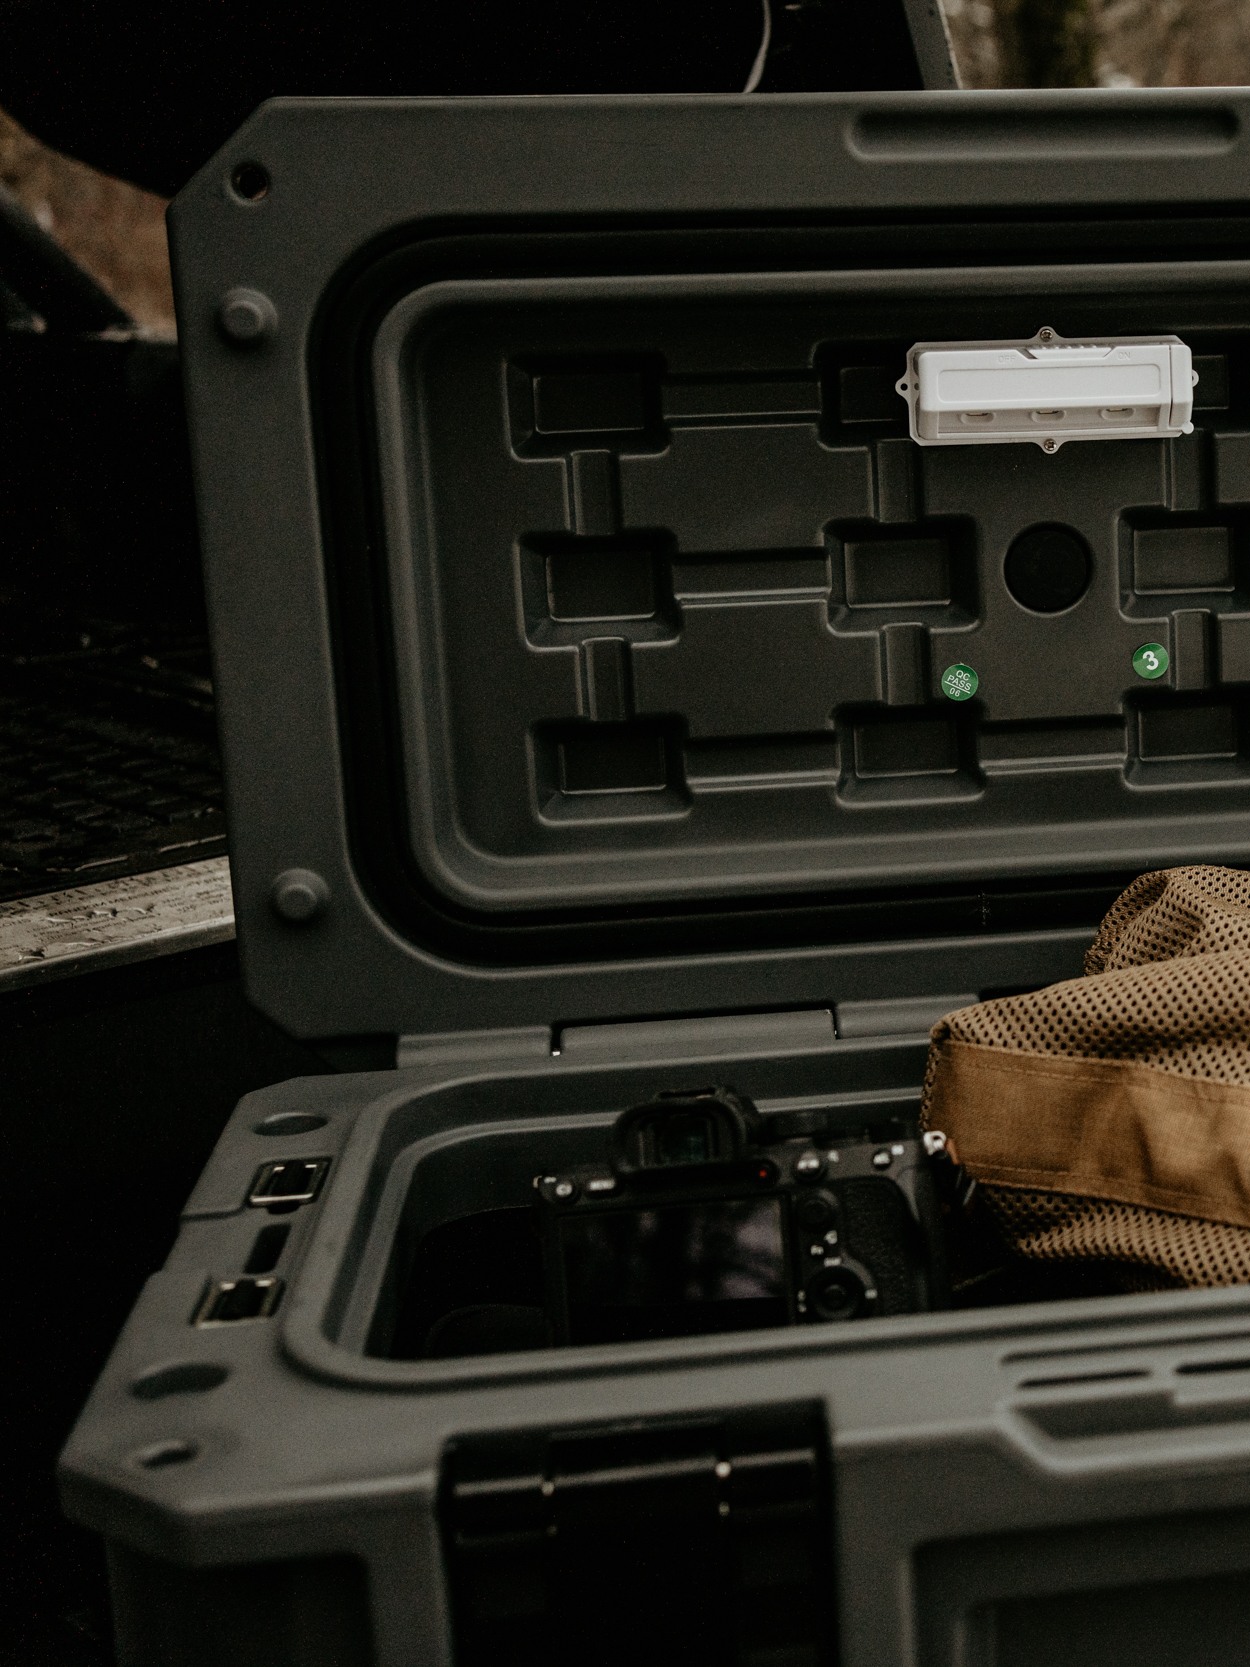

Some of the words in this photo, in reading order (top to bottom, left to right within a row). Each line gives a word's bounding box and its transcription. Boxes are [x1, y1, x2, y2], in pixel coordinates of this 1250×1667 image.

[998, 355, 1016, 364] OFF
[1117, 351, 1131, 360] ON
[1142, 651, 1159, 670] 3
[956, 670, 970, 681] QC
[947, 675, 972, 691] PASS
